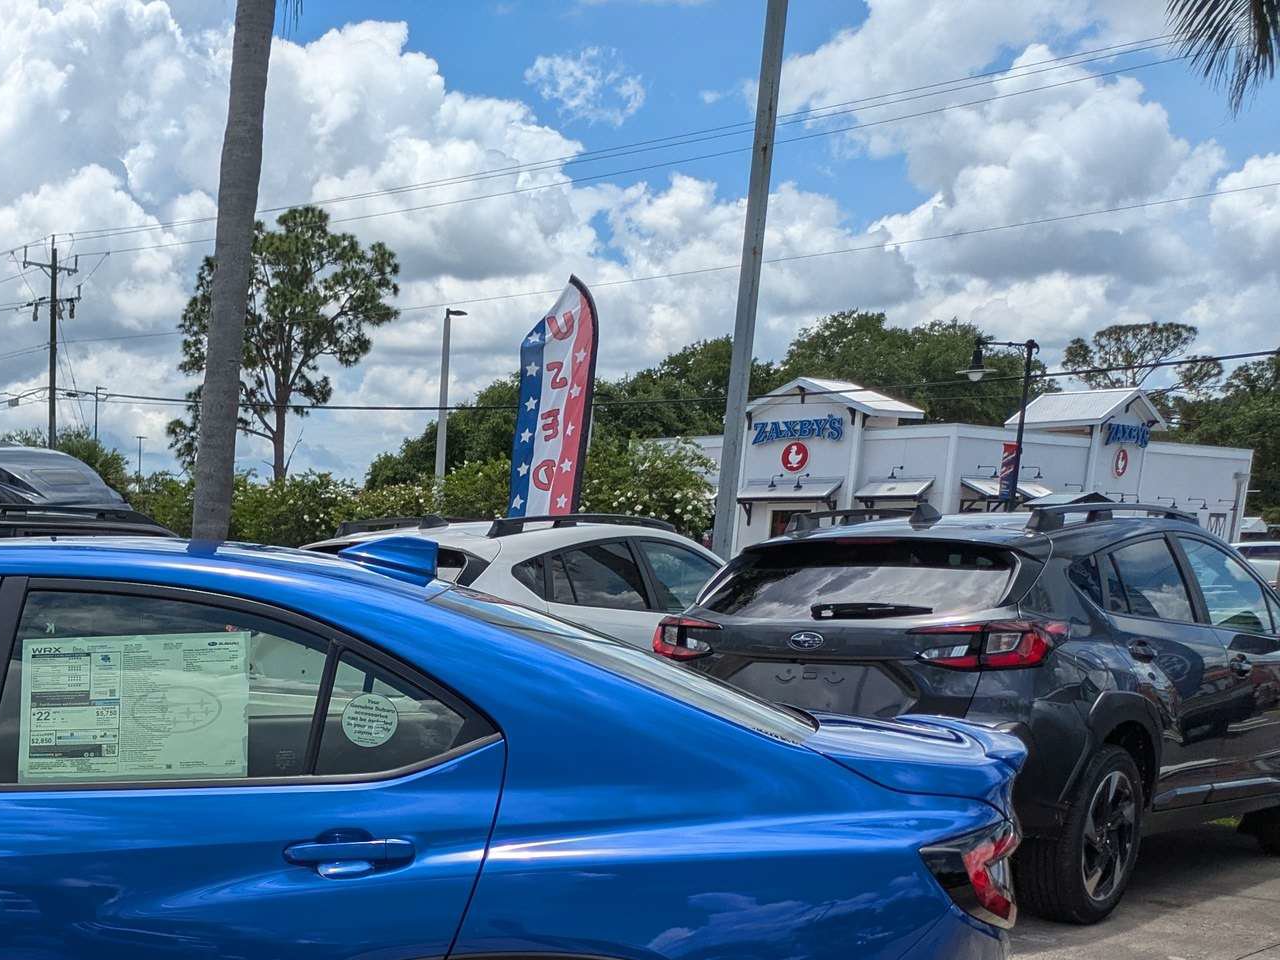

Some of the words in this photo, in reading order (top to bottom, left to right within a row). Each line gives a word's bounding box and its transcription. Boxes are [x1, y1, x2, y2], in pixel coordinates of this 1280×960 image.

[752, 414, 843, 446] ZAXBY'S
[31, 646, 61, 654] WRX
[36, 711, 51, 721] 22
